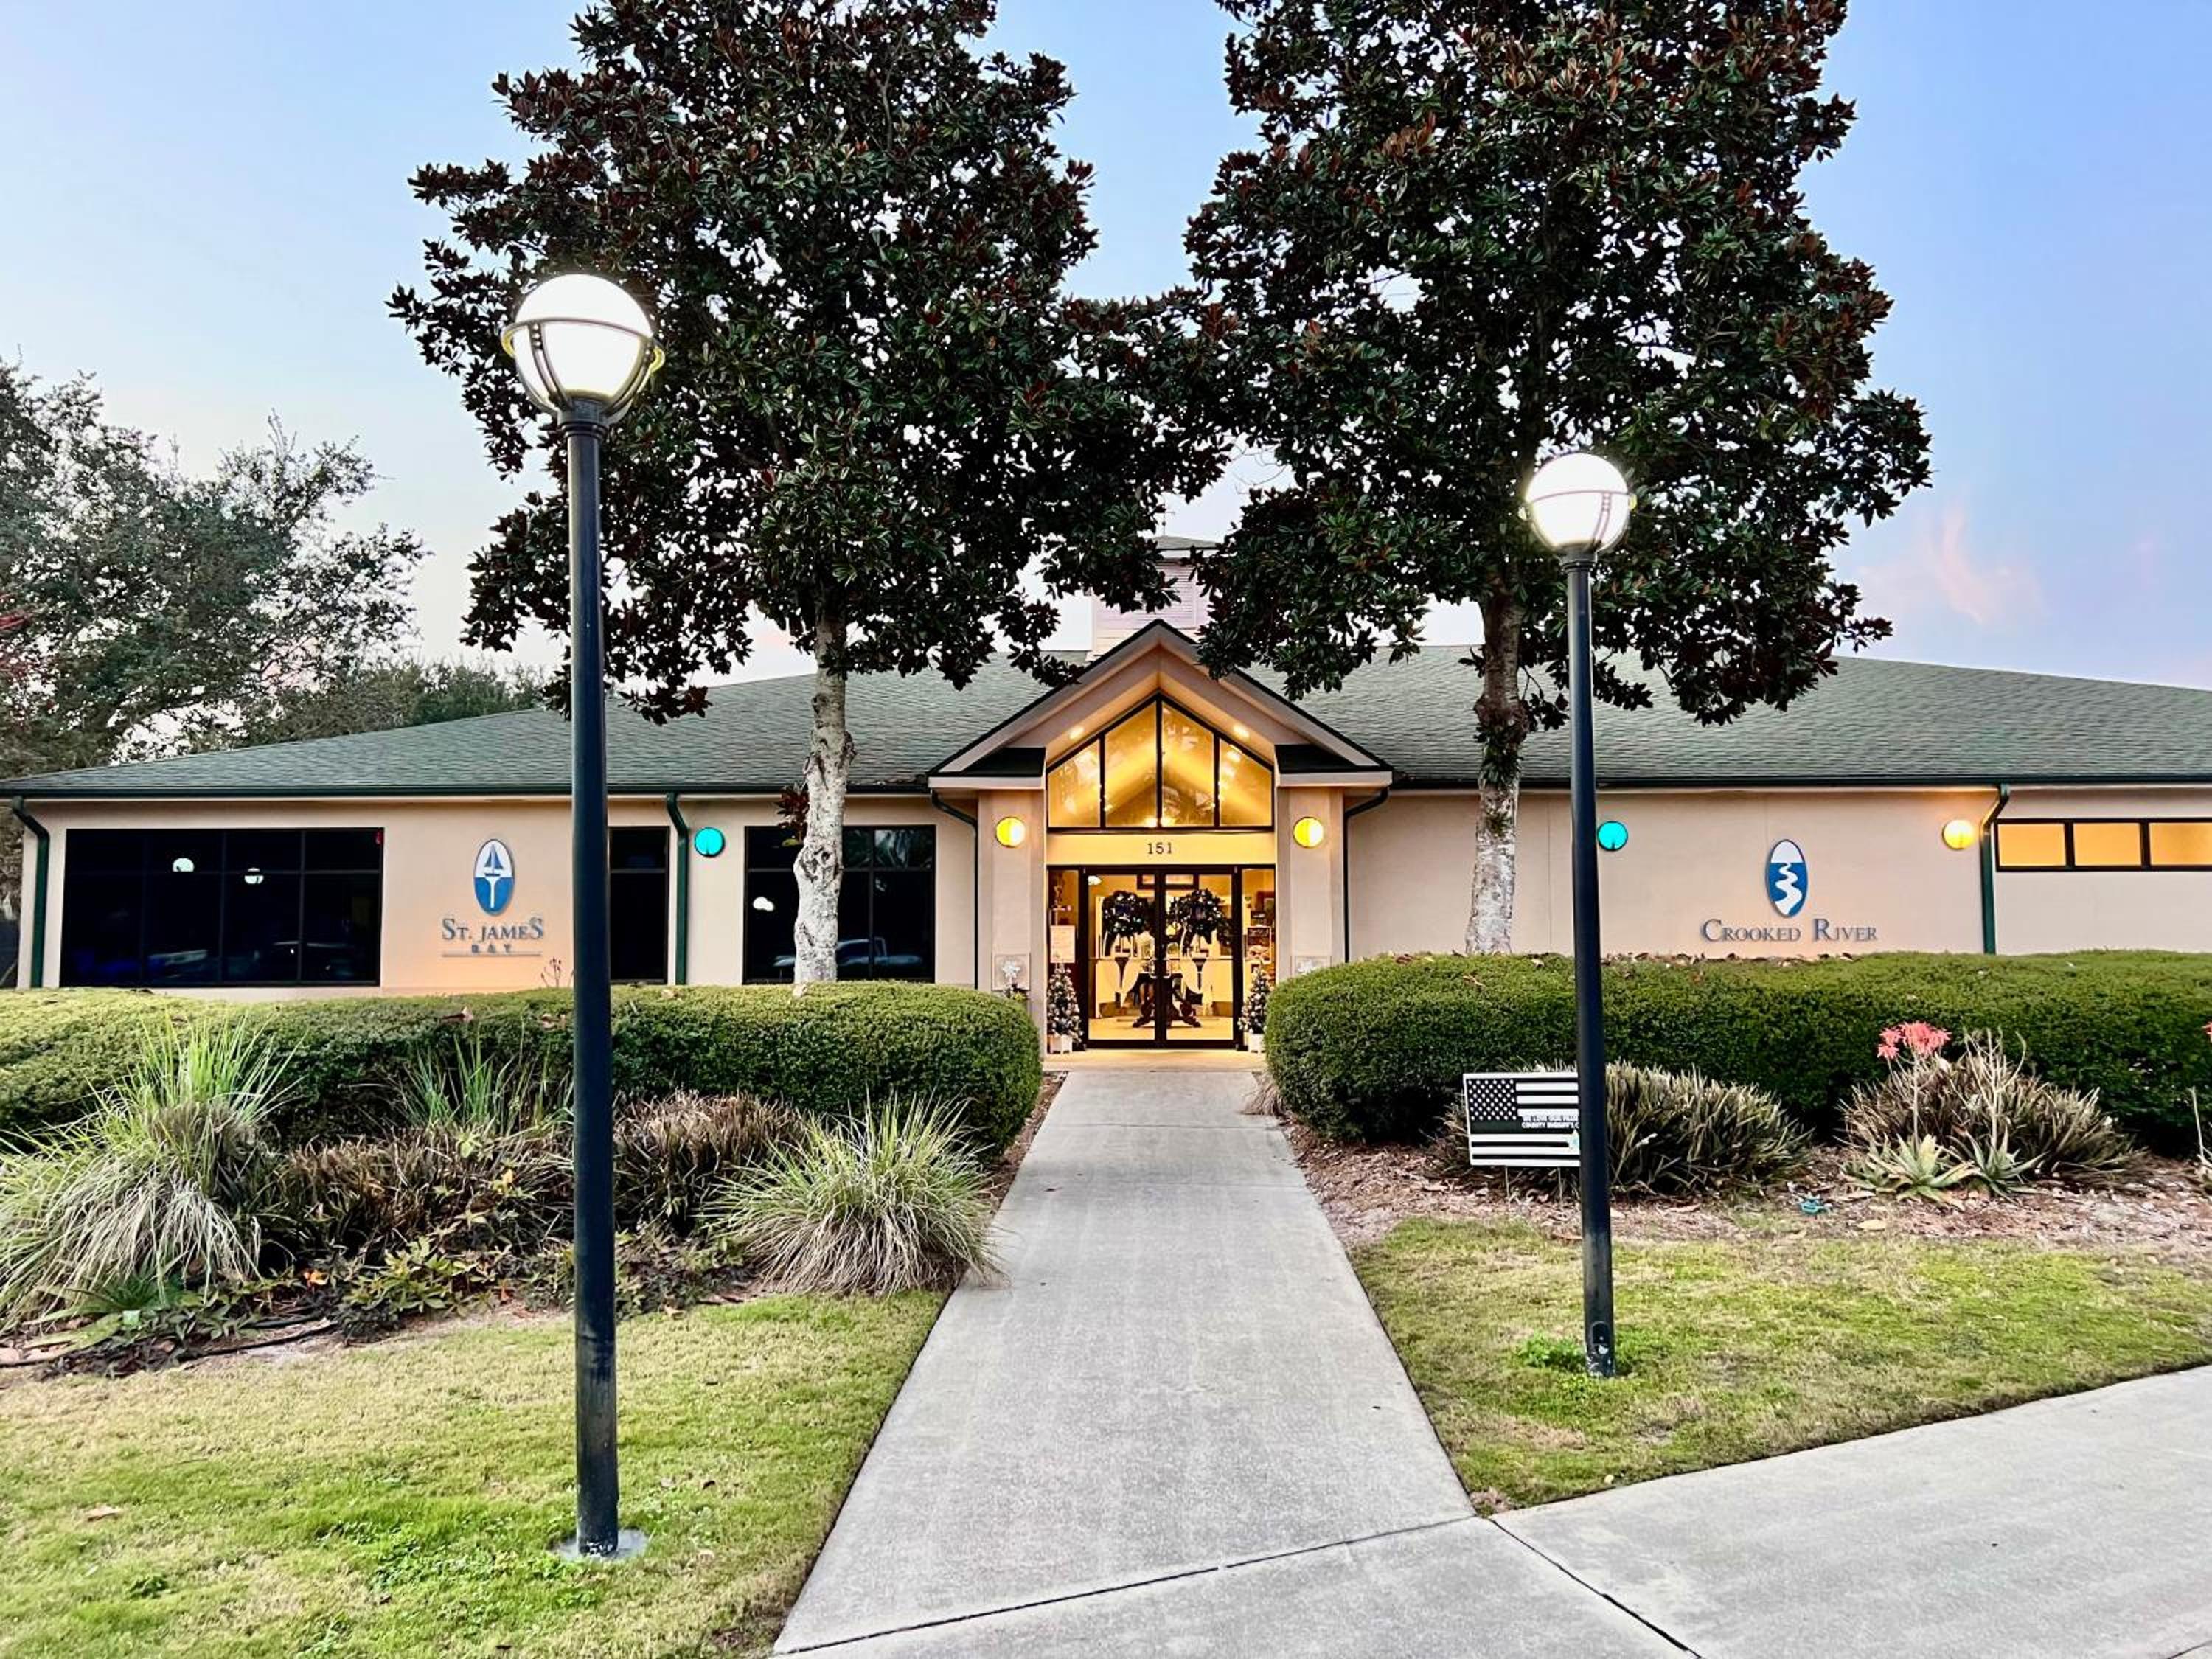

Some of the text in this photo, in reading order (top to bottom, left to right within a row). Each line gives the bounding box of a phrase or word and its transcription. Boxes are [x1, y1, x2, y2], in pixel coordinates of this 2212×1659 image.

[1147, 841, 1172, 855] 151
[480, 917, 543, 942] JAMES
[1700, 918, 1877, 942] CROOKED RIVER
[471, 943, 512, 953] BAY
